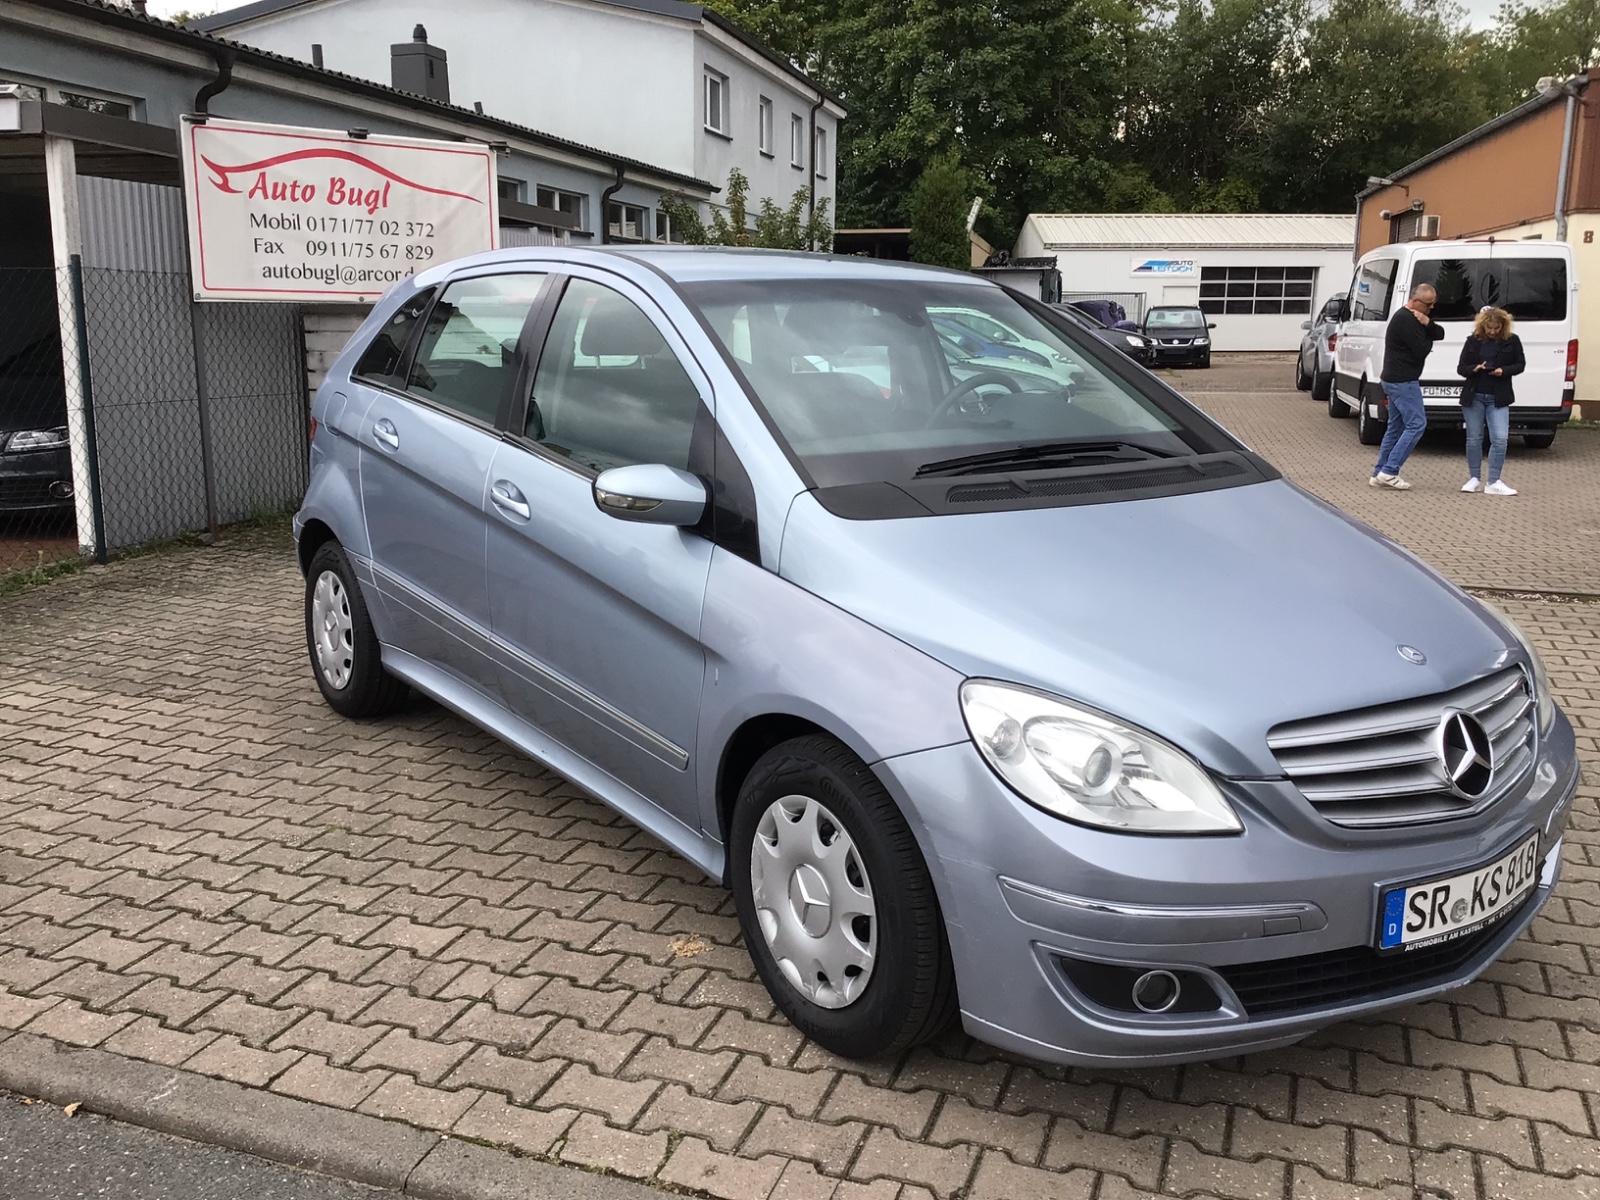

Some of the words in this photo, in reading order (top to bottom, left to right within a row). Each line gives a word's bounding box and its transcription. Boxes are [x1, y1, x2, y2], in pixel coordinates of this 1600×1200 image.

[248, 171, 316, 203] Auto
[326, 176, 391, 215] Bugl
[249, 212, 301, 231] Mobil
[306, 216, 374, 235] 0171/77
[379, 220, 400, 236] 02
[405, 221, 435, 238] 372
[253, 238, 285, 255] Fax
[306, 240, 374, 259] 0911/75
[379, 244, 398, 260] 67
[405, 244, 434, 260] 829
[1406, 885, 1451, 932] SR
[1470, 865, 1503, 917] KS
[1505, 841, 1535, 896] 818
[1388, 923, 1397, 936] D
[1404, 934, 1448, 952] AUTOMOBILE
[1448, 931, 1459, 940] AM
